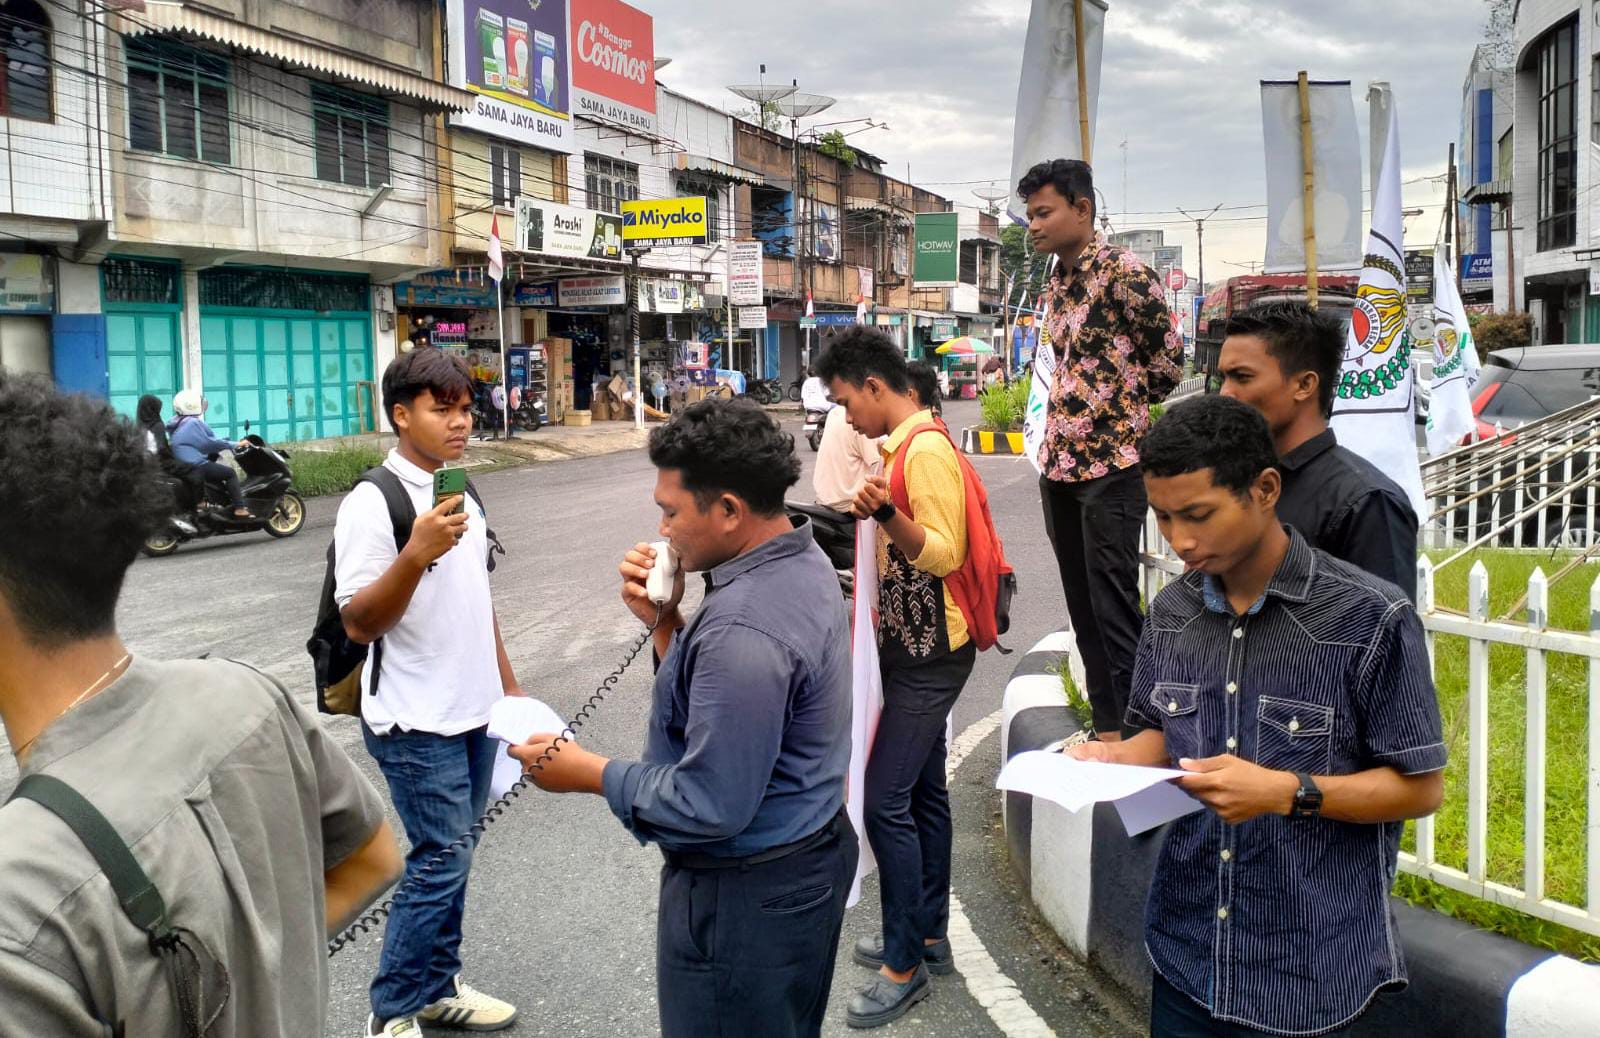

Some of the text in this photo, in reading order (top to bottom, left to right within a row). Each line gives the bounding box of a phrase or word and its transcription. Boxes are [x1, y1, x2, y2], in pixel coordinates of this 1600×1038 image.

[577, 20, 648, 85] Cosmos
[477, 102, 562, 138] SAMA JAYA BARU
[581, 97, 651, 130] SAMA JAYA BARU
[639, 206, 702, 230] Miyako
[634, 237, 693, 247] SAMA JAYA BARU
[917, 240, 954, 250] HOTWAV
[1472, 258, 1491, 266] ATM
